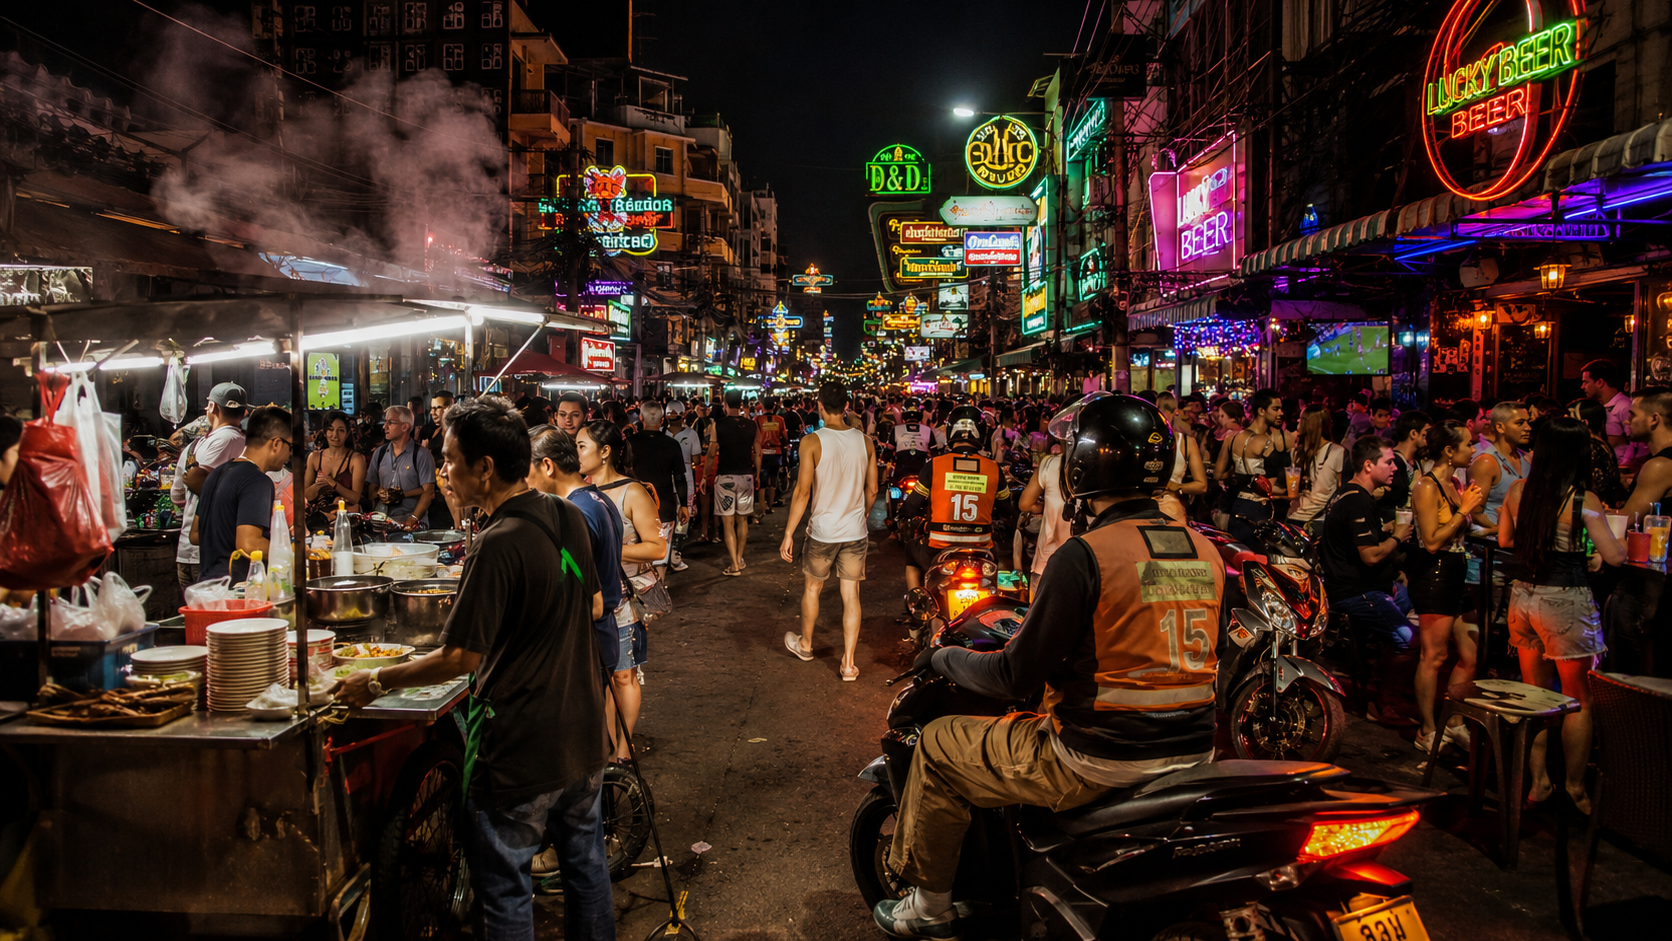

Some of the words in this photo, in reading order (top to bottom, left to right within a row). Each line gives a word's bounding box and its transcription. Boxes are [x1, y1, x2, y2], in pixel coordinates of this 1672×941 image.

[1427, 54, 1497, 116] LUCKY
[1498, 23, 1571, 87] BEER
[1452, 88, 1526, 138] BEER
[870, 165, 921, 191] D&D
[1181, 211, 1229, 260] BEER
[951, 493, 979, 521] 15
[1160, 608, 1210, 673] 15
